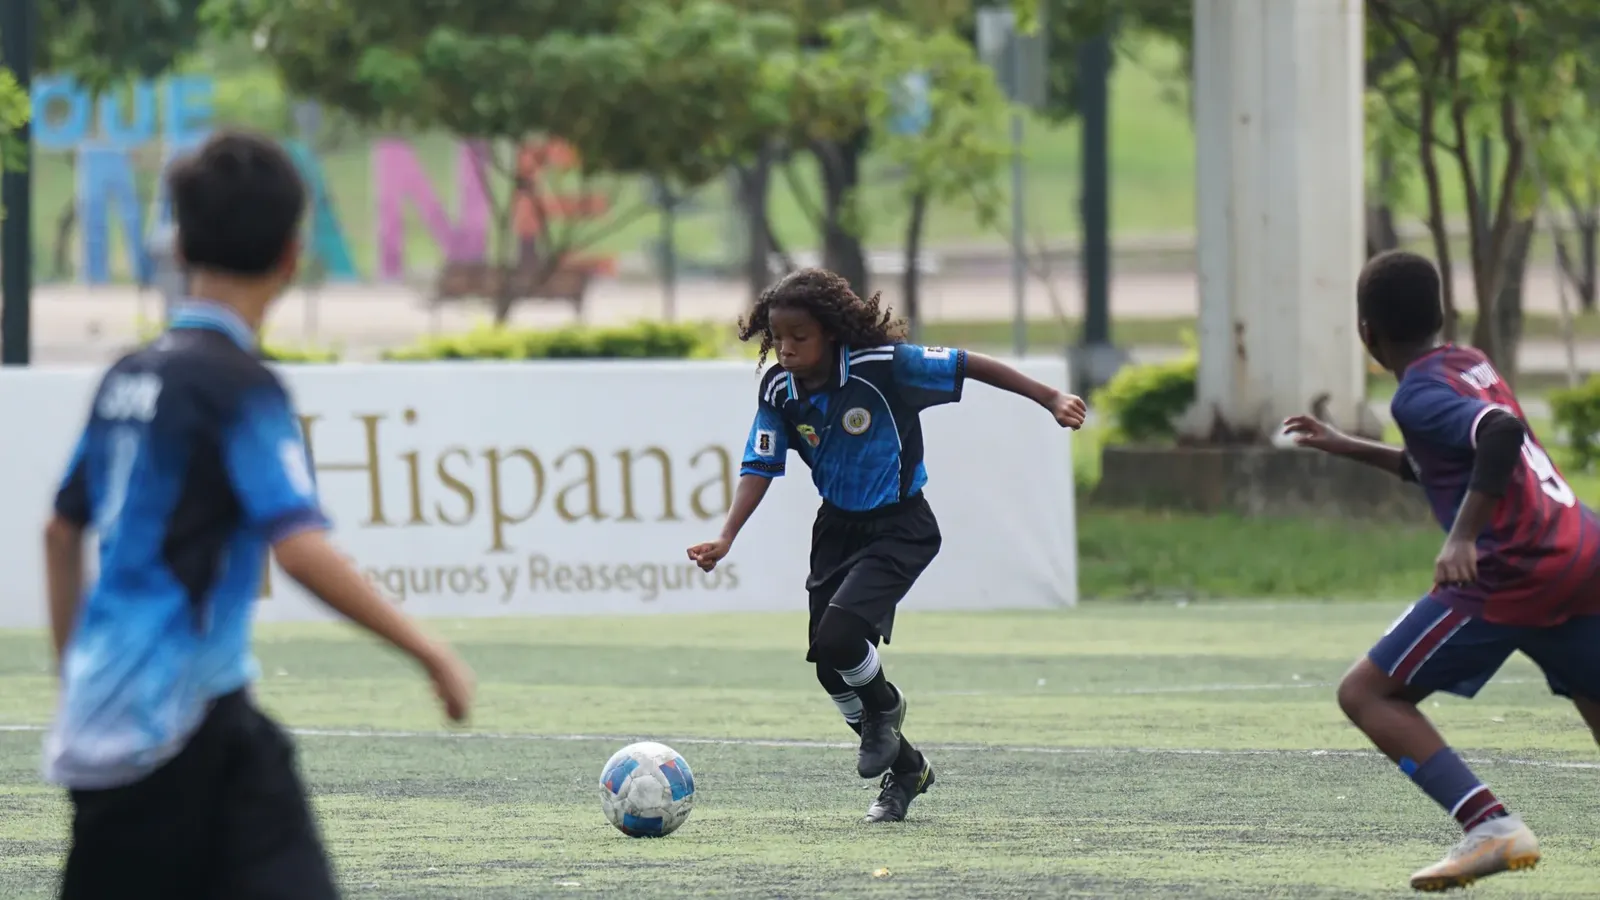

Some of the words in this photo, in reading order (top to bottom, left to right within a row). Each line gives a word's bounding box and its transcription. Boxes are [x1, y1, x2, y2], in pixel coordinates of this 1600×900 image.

[298, 407, 735, 554] Hispana
[361, 563, 489, 603] eguros
[497, 564, 519, 604] y
[528, 554, 740, 602] Reaseguros
